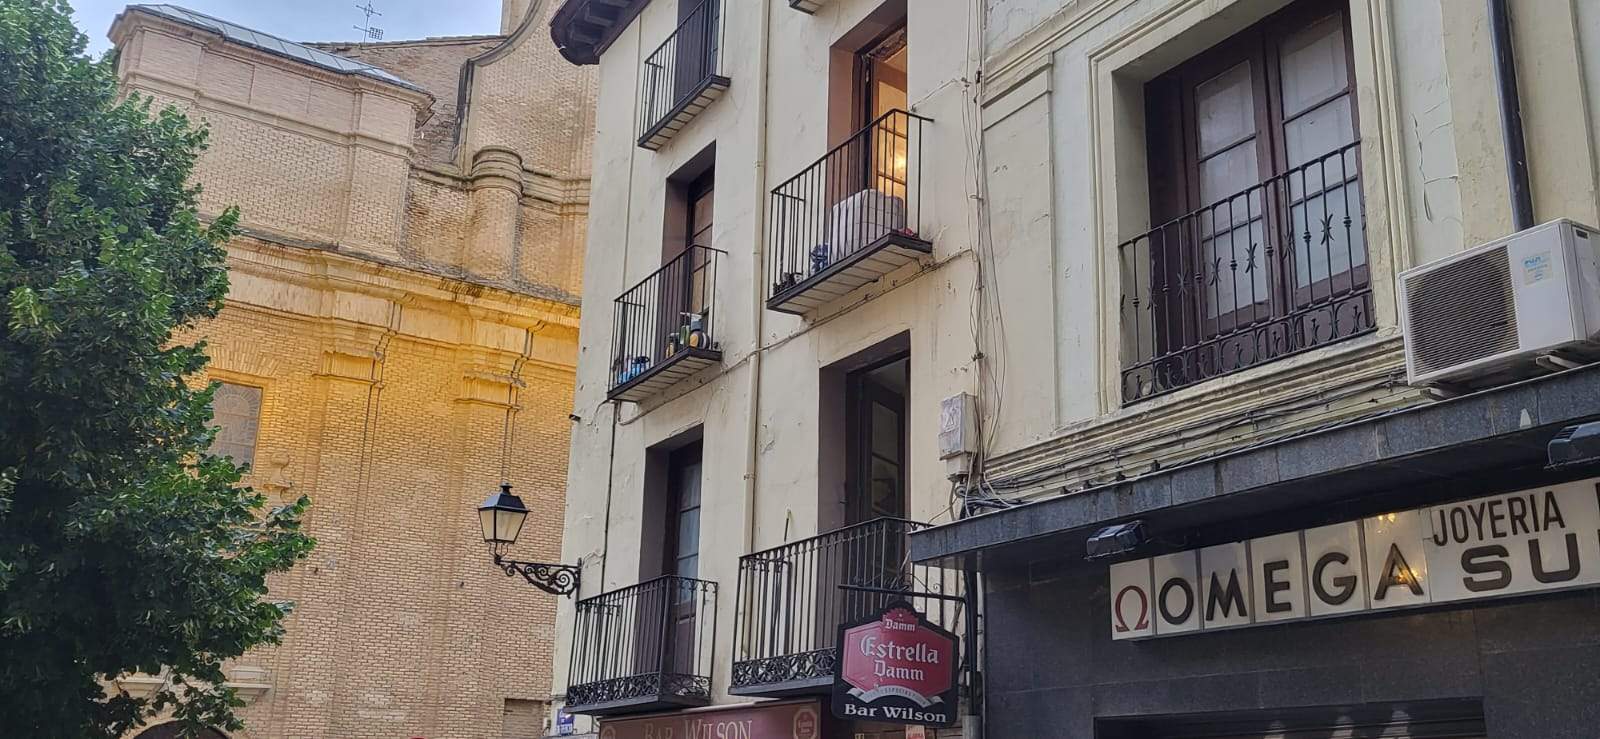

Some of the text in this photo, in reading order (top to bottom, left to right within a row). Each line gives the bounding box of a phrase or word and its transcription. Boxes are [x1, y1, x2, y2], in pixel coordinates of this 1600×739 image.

[1433, 491, 1566, 546] JOYERIA
[1461, 530, 1600, 592] SU
[1158, 543, 1424, 625] OMEGA
[884, 618, 916, 632] Damm
[859, 634, 939, 663] Estrella
[874, 660, 924, 681] Damm
[844, 703, 946, 723] Bar Wilson
